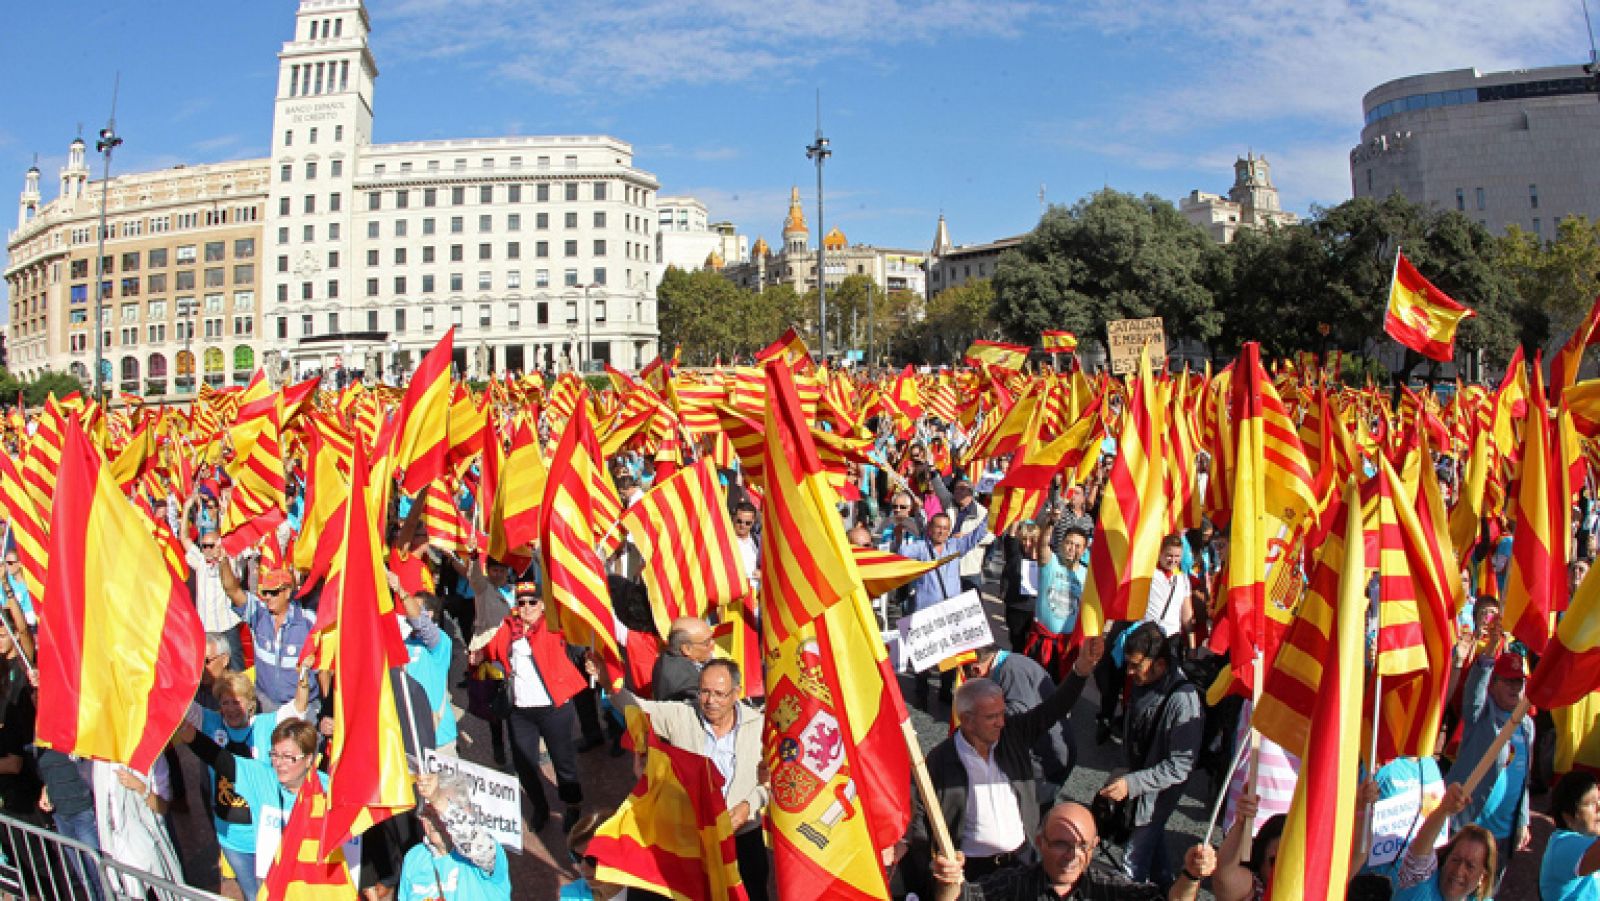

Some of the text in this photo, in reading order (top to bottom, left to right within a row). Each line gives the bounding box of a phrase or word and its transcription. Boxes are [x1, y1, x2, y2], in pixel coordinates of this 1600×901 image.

[285, 104, 313, 115] BANCO
[293, 114, 303, 123] DE
[489, 781, 516, 801] som
